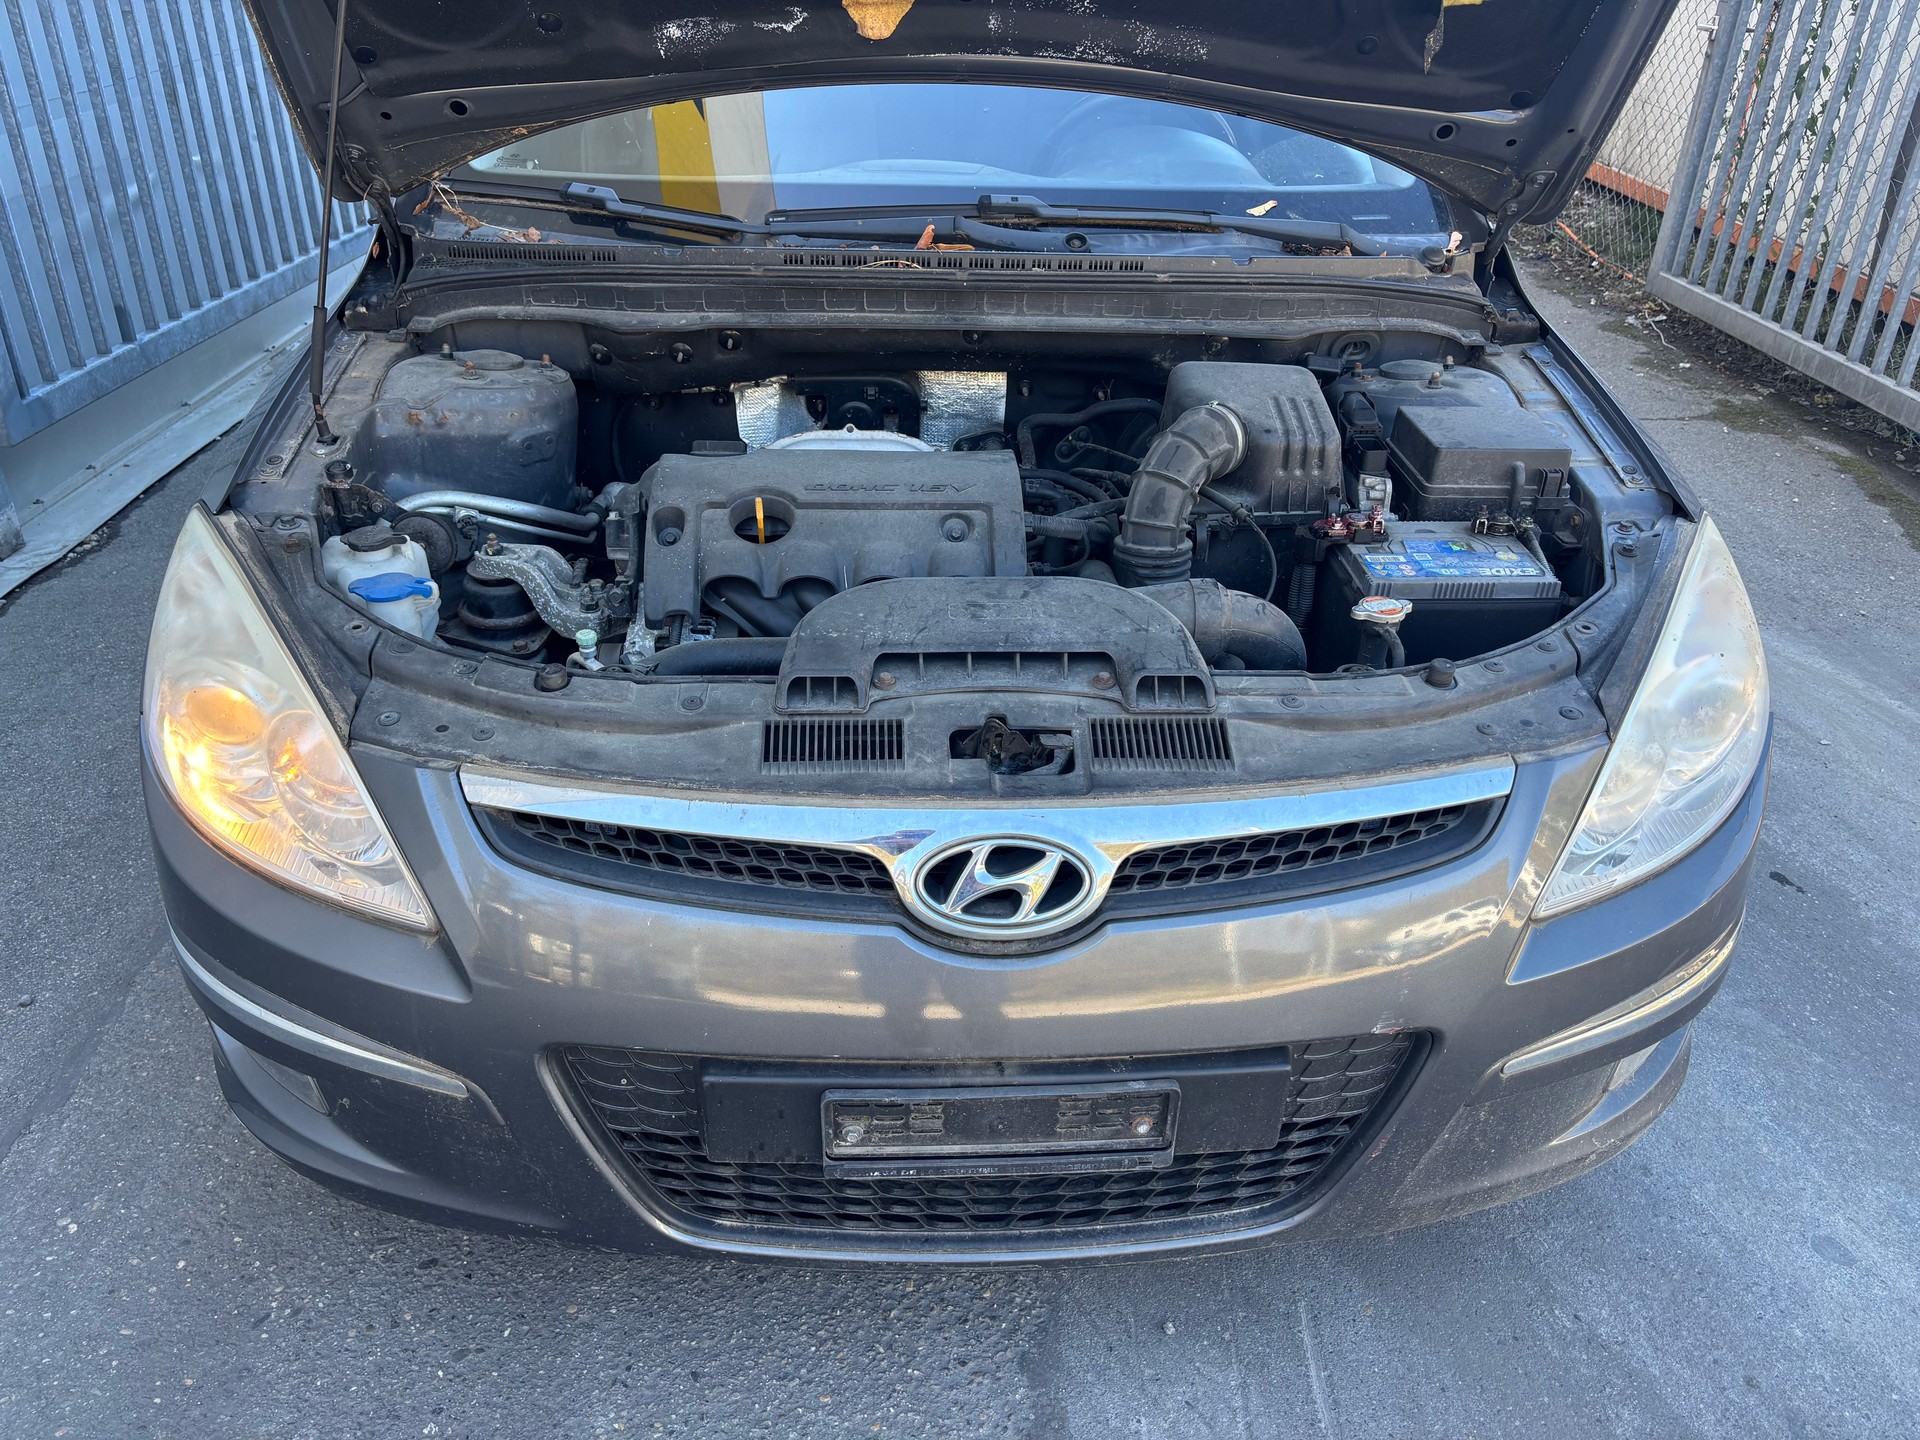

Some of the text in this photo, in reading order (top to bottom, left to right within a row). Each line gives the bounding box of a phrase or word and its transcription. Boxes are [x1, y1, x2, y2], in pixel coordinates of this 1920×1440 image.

[803, 483, 977, 493] DOHC 16V
[1478, 567, 1540, 577] EXIDE
